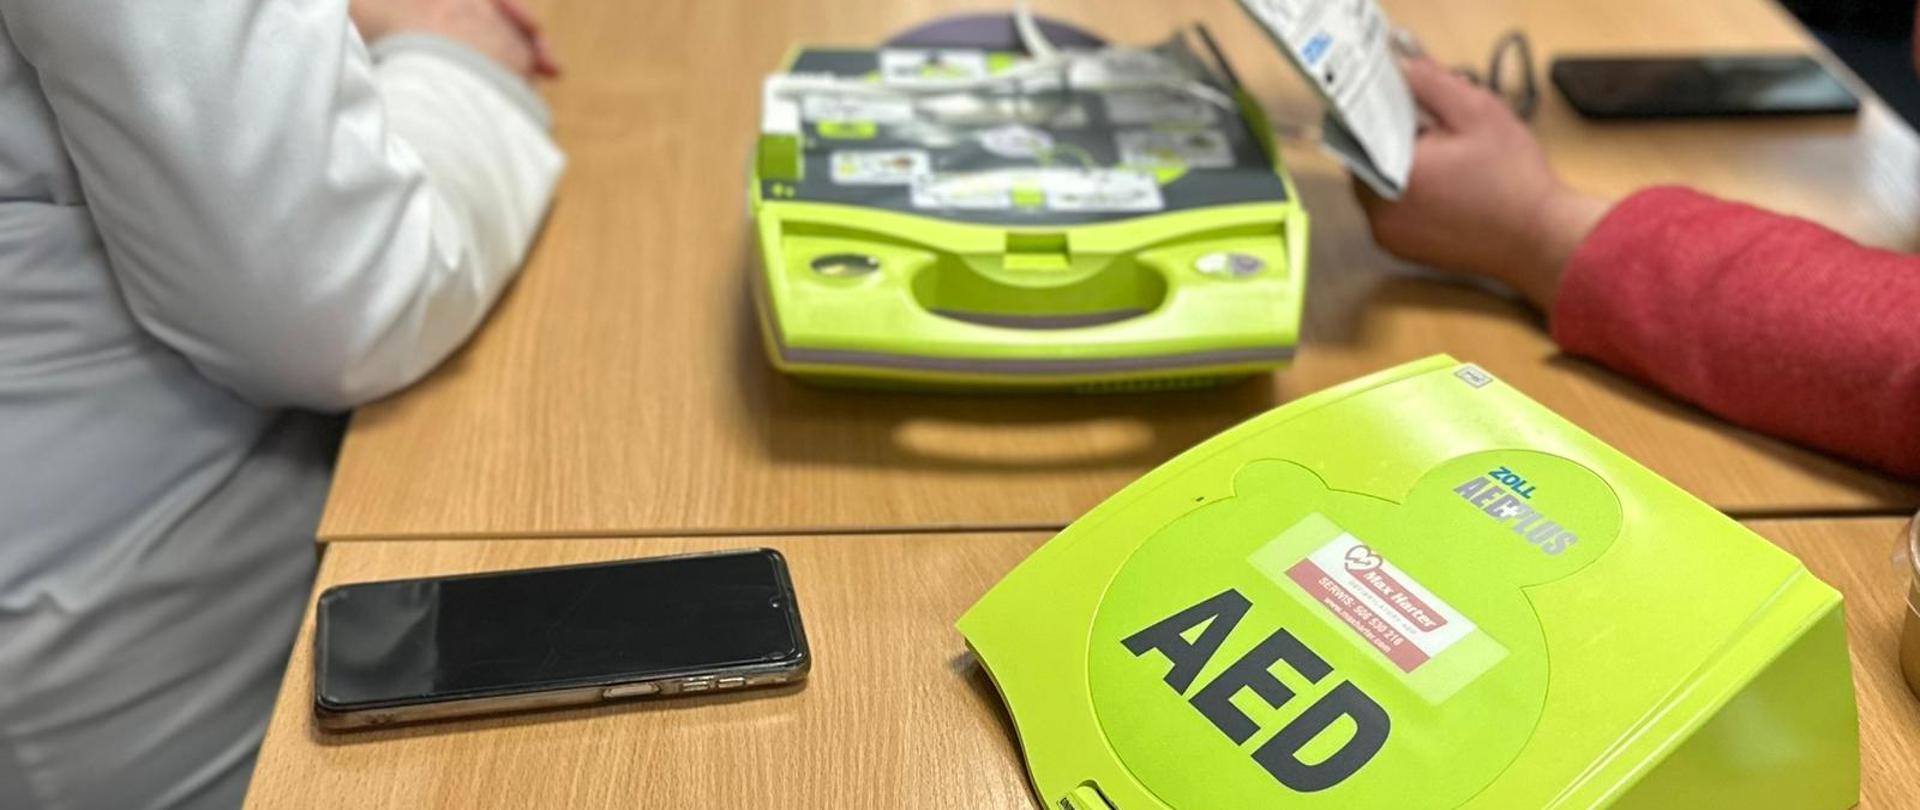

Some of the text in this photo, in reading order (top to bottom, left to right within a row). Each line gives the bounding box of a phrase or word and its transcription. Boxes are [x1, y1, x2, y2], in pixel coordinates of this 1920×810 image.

[1488, 466, 1536, 499] ZOLL
[1318, 577, 1356, 608] SERWIS:
[1363, 570, 1438, 627] Max Harter
[1120, 588, 1391, 793] AED
